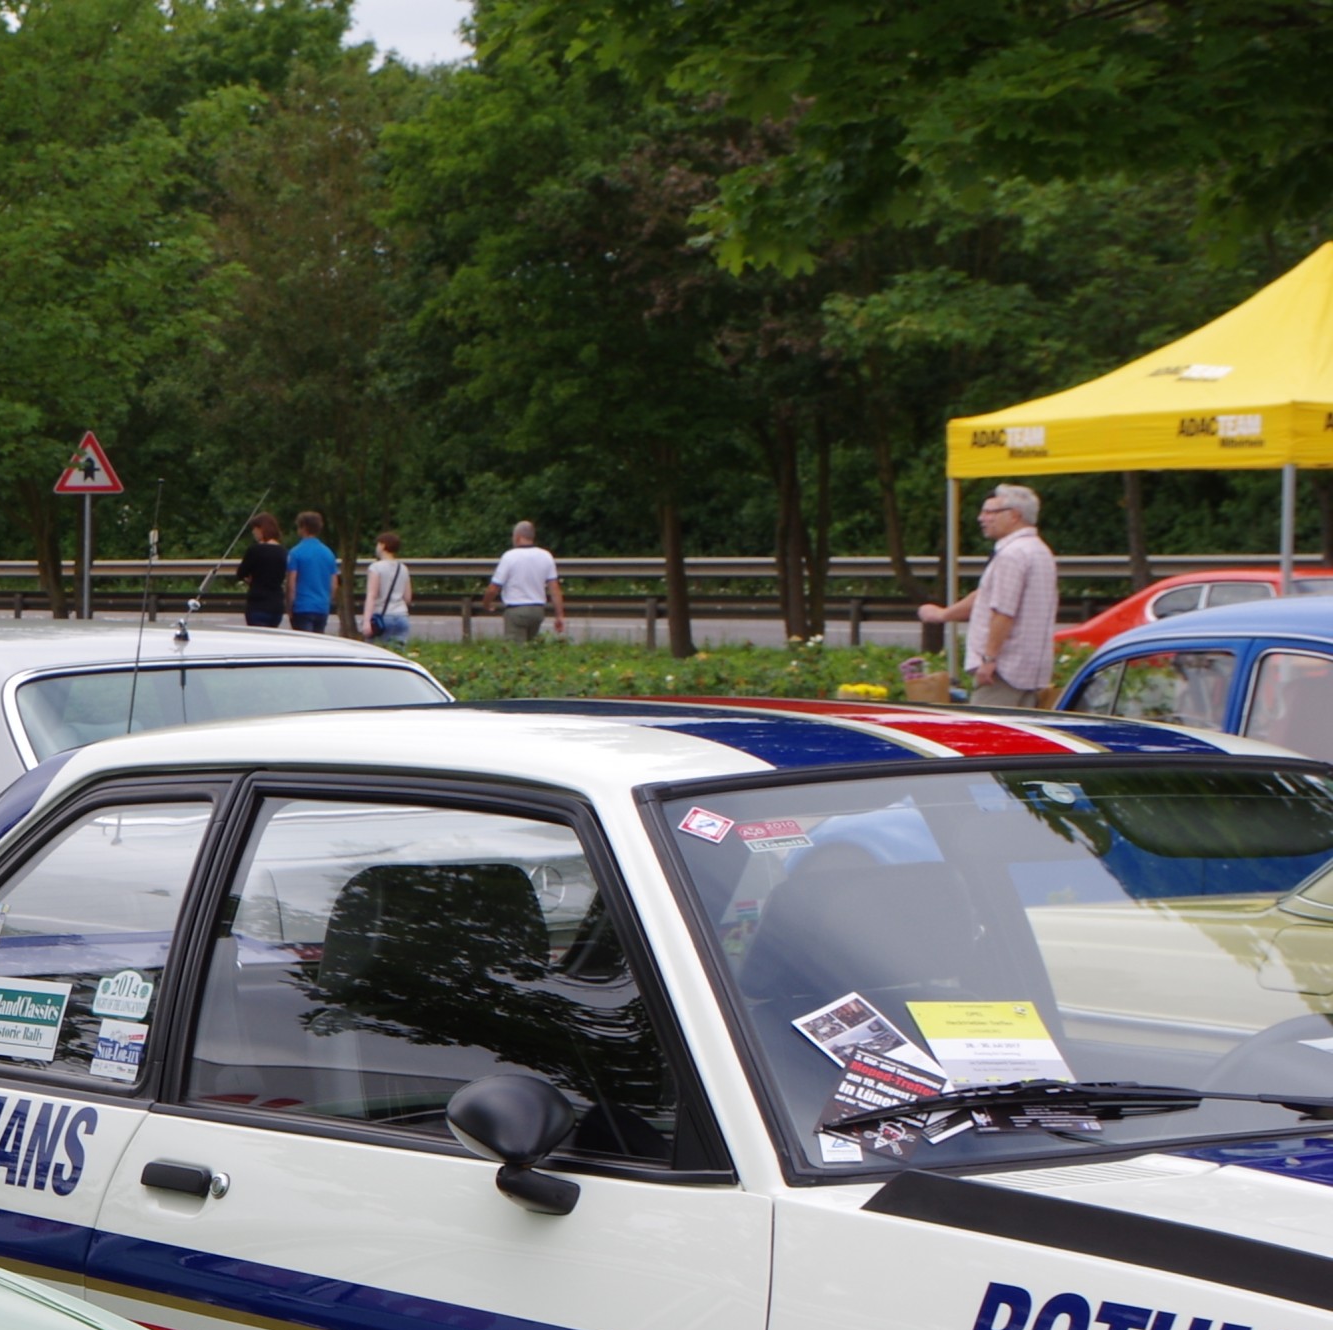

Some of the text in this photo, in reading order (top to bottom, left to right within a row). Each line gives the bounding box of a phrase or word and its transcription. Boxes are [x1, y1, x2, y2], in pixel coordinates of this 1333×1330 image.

[110, 975, 140, 998] 2014
[22, 1025, 43, 1046] Rally
[838, 1081, 856, 1096] in
